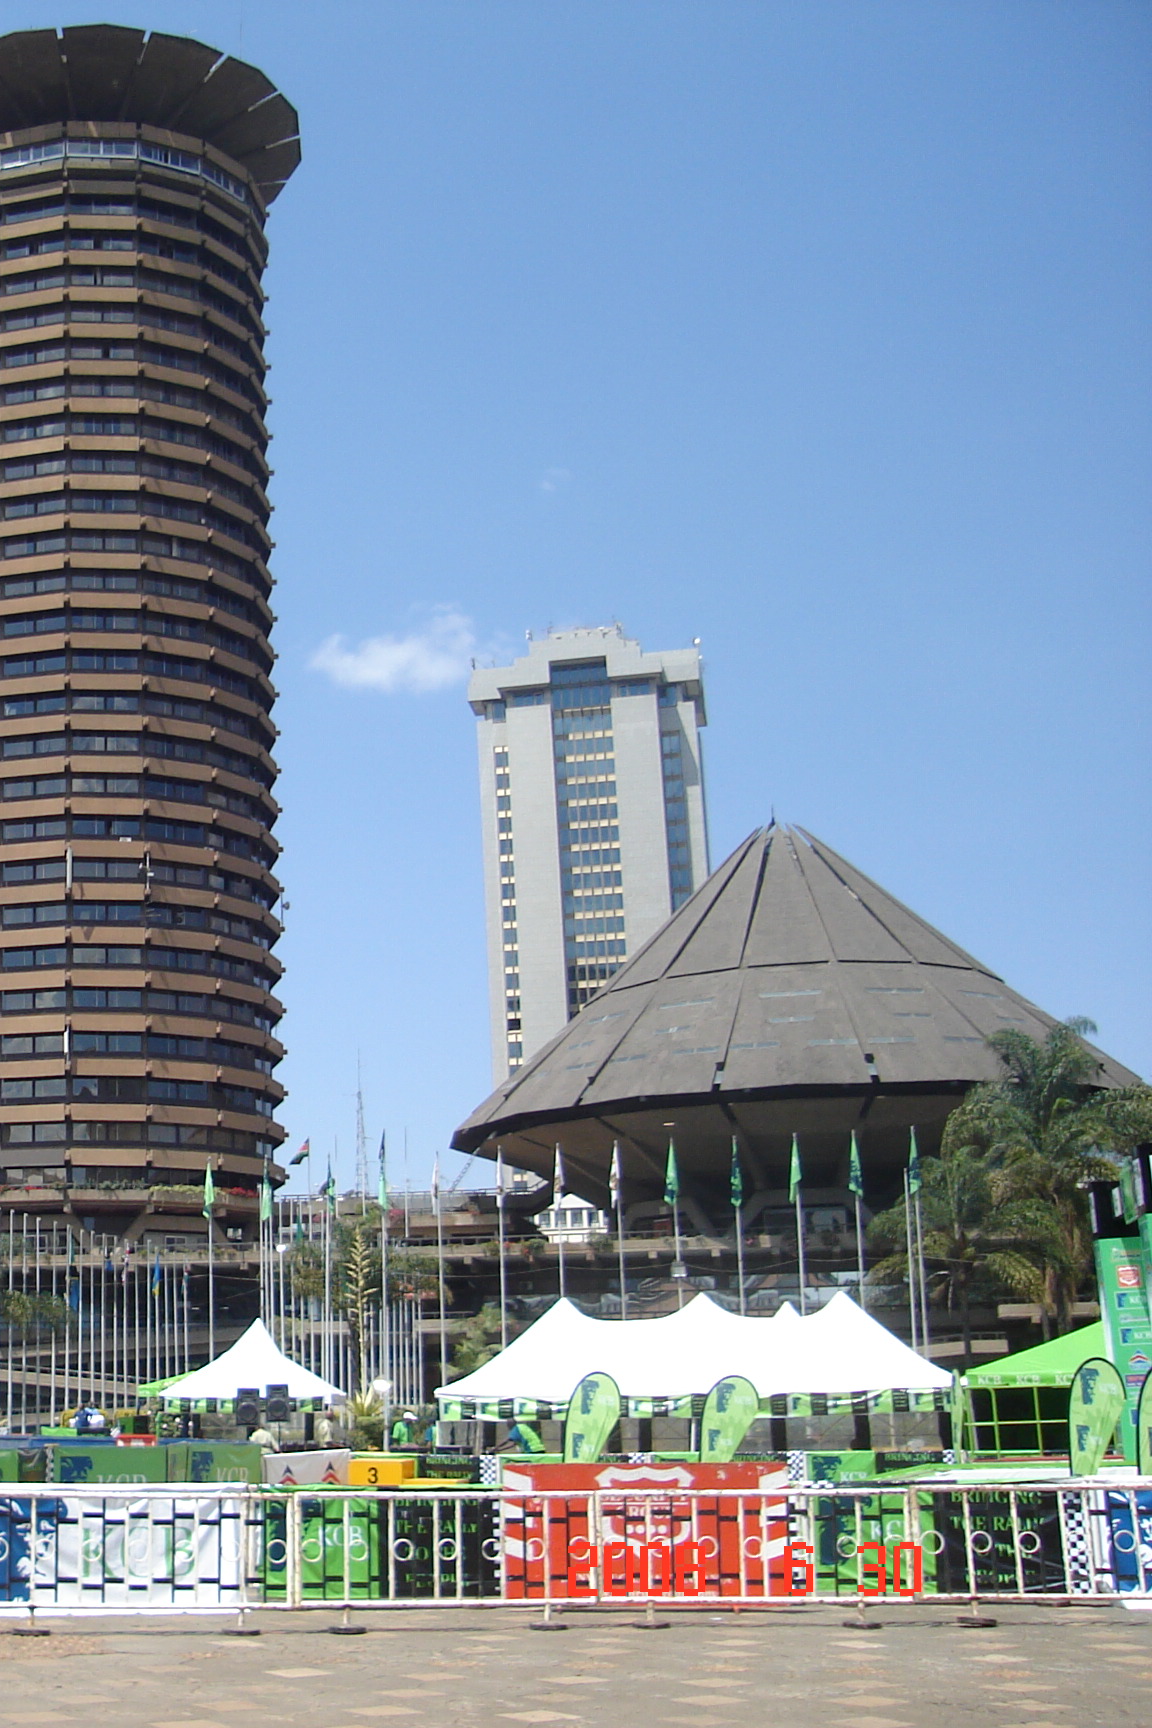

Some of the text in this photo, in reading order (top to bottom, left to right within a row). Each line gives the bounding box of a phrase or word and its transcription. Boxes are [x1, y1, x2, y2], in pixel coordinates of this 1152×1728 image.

[978, 1375, 1003, 1385] KCB
[1055, 1375, 1075, 1385] KC
[368, 1467, 378, 1483] 3
[318, 1524, 362, 1546] KCB
[82, 1526, 196, 1578] KCB
